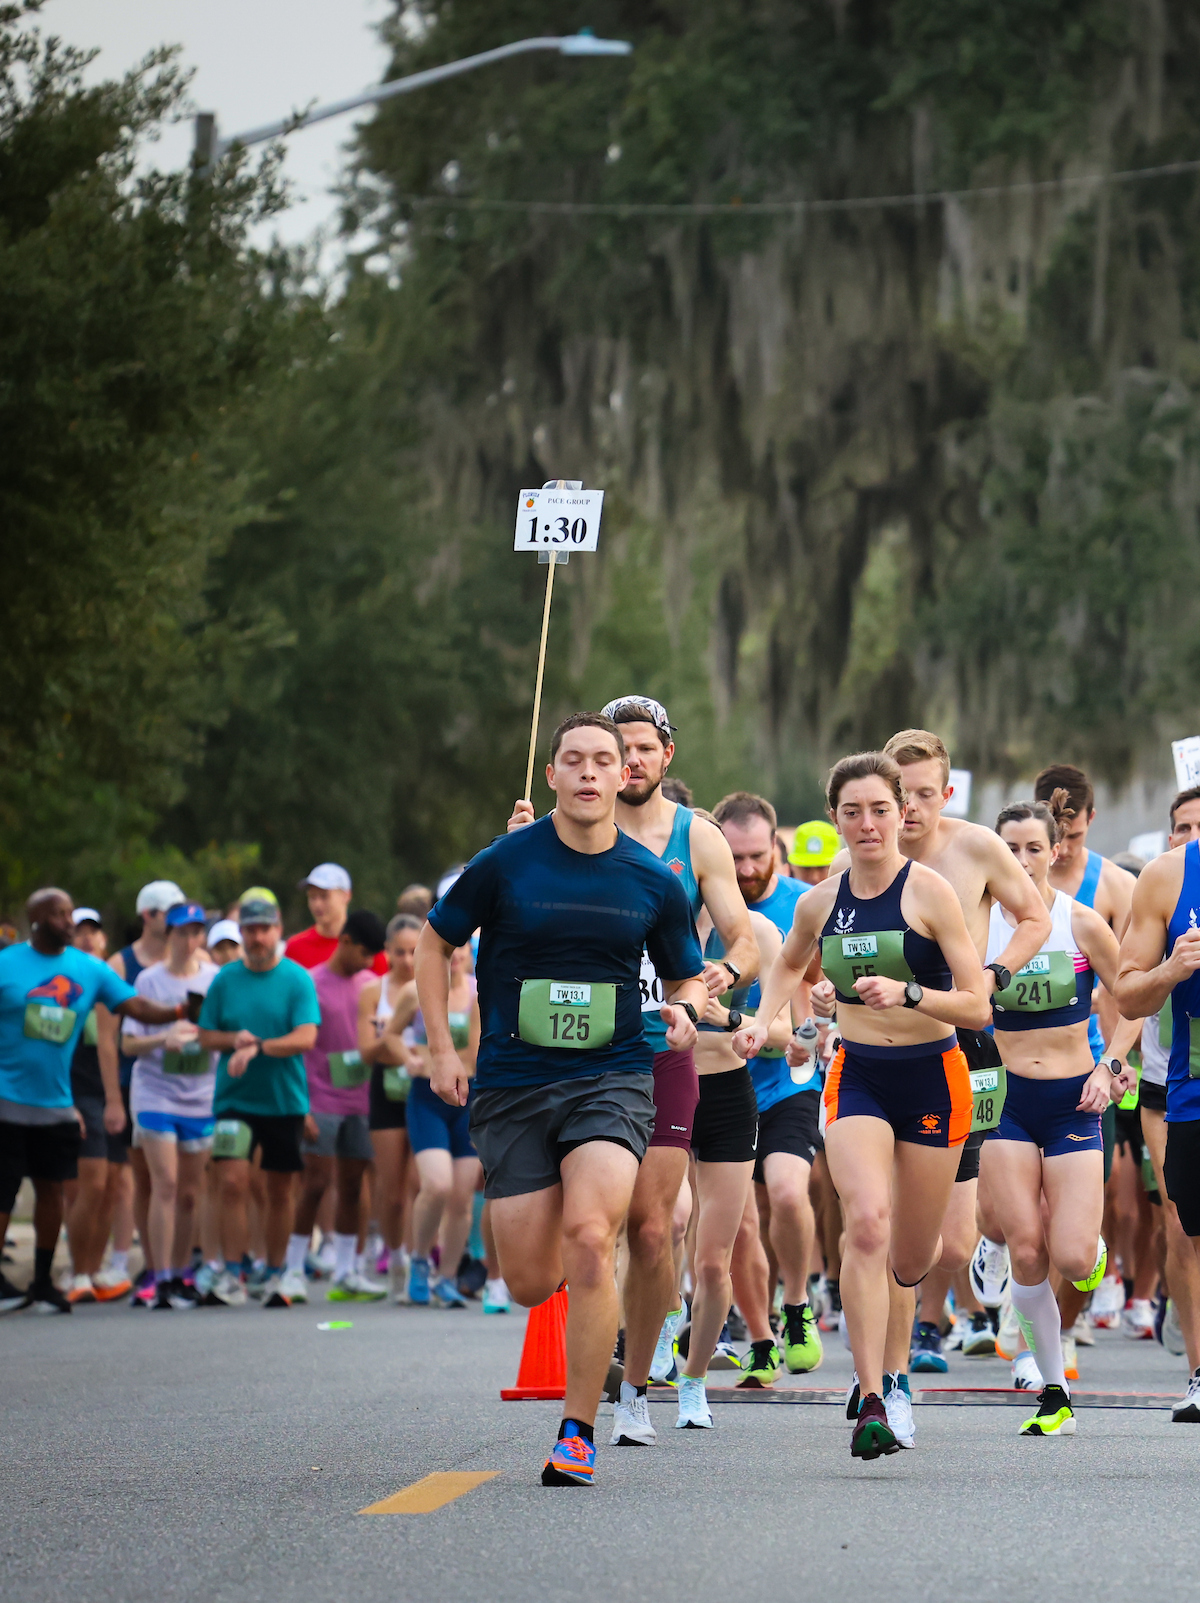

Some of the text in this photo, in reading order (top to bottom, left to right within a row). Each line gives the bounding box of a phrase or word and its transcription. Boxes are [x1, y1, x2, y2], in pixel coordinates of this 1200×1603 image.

[527, 516, 587, 544] 1:30
[847, 943, 859, 953] TW
[556, 989, 569, 999] TW
[1015, 980, 1052, 1006] 241
[549, 1012, 590, 1042] 125
[974, 1079, 984, 1088] TW
[976, 1098, 994, 1124] 48
